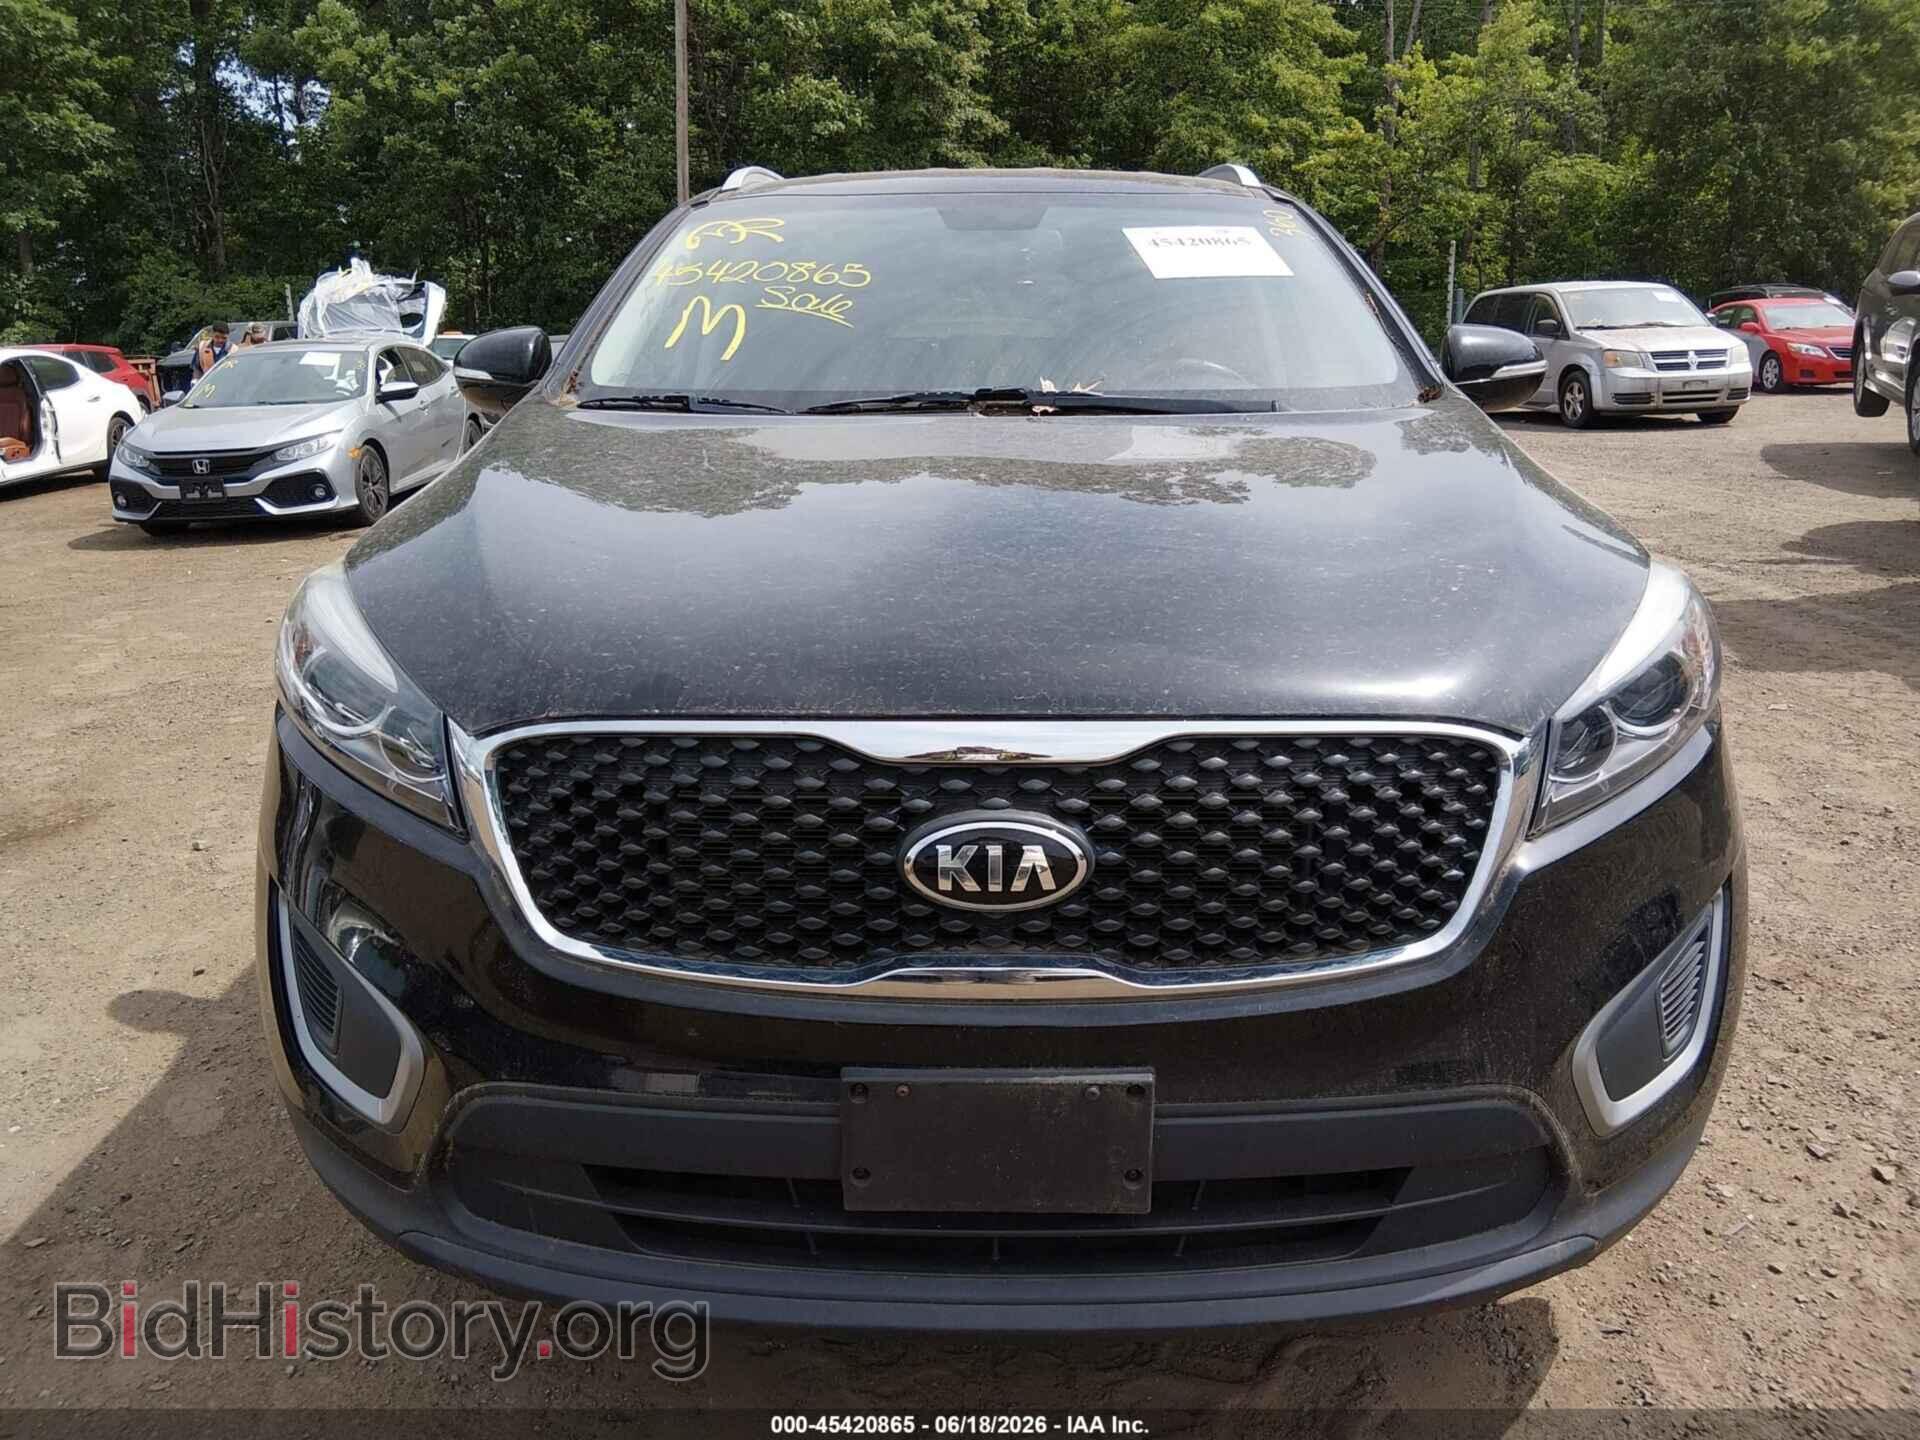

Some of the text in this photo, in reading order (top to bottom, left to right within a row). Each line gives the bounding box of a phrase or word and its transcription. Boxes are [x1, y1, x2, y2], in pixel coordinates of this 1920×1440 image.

[654, 259, 871, 287] 45420865
[758, 286, 854, 321] Sale
[664, 295, 746, 361] M
[935, 845, 1057, 892] KIA
